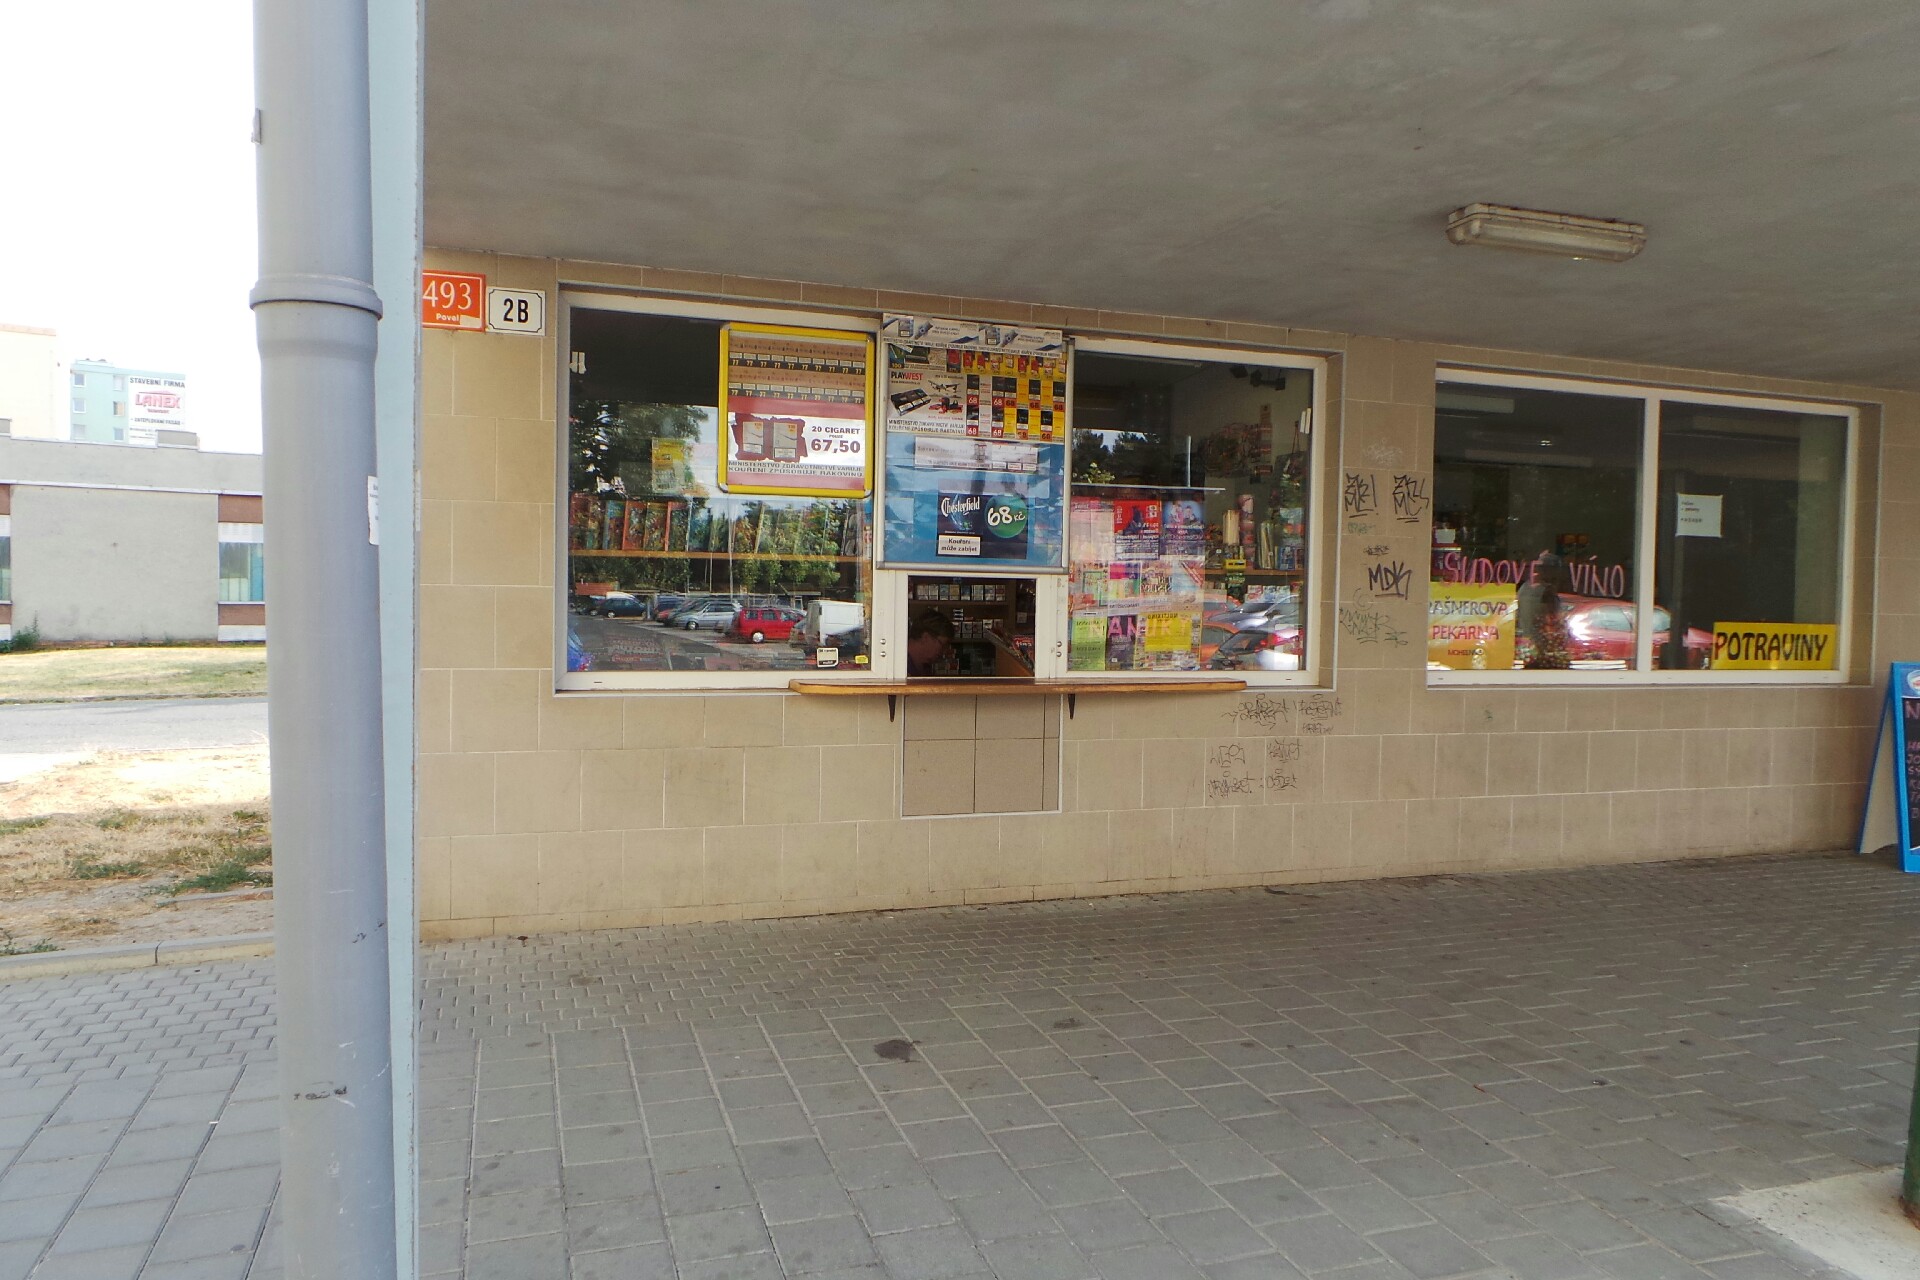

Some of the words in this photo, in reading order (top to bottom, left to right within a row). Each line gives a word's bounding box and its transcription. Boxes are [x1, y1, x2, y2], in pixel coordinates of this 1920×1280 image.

[422, 280, 472, 310] 493
[503, 298, 529, 323] 2B
[164, 380, 185, 388] FIRMA
[825, 426, 861, 435] CIGARET
[967, 427, 977, 435] 68
[811, 439, 861, 454] 67,50
[728, 461, 780, 469] MINISTERSTVO
[941, 496, 980, 518] Chesterfield
[987, 507, 1012, 526] 68
[1441, 550, 1550, 588] SUDOVÉ
[1569, 555, 1624, 597] VÍNO
[1432, 621, 1499, 640] PEKÁRNA
[1714, 632, 1828, 661] POTRAVINY
